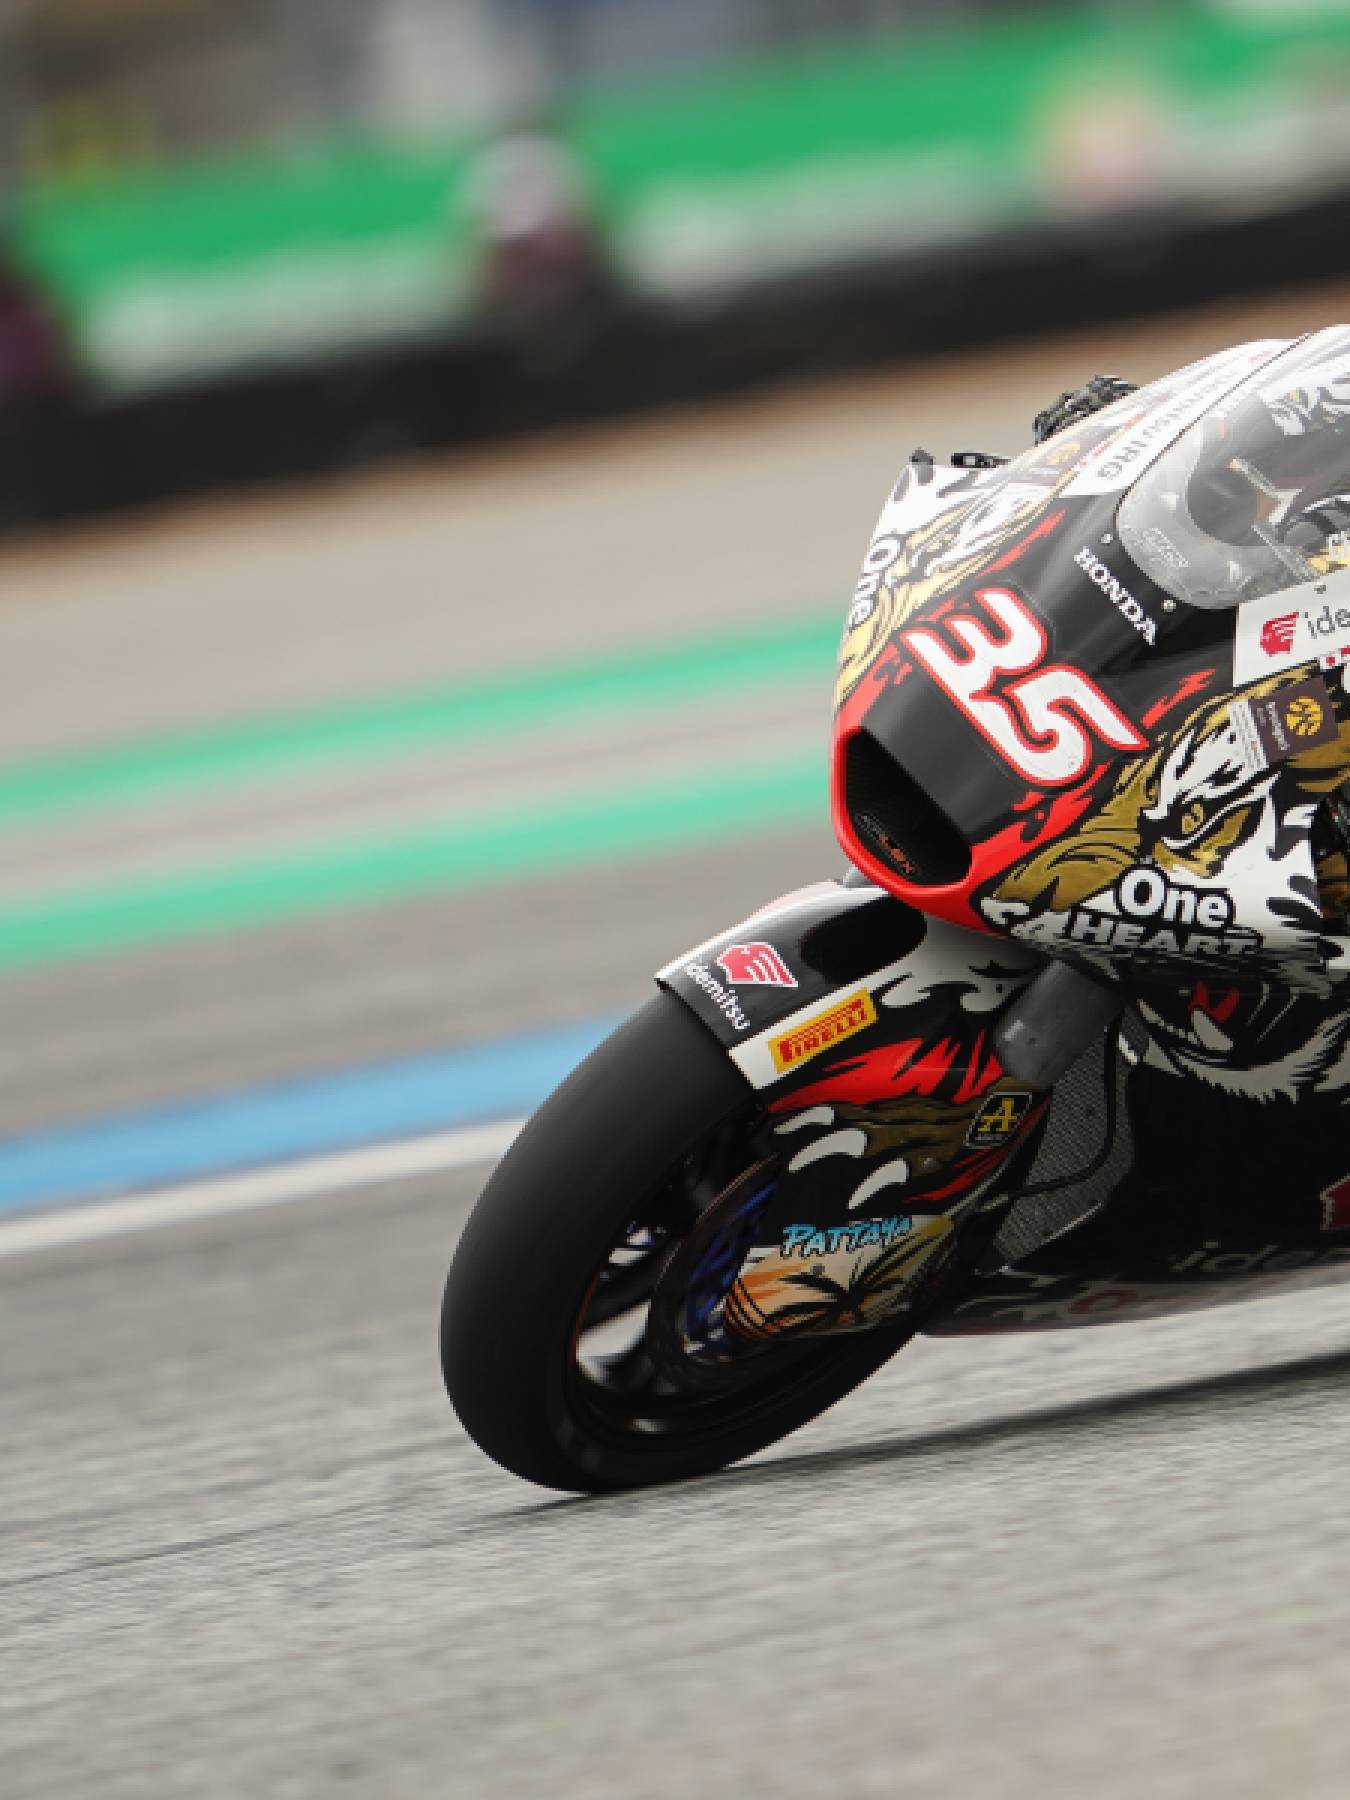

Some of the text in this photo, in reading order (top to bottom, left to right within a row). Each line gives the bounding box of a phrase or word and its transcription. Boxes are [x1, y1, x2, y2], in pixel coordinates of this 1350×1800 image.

[1074, 546, 1158, 646] HONDA
[901, 586, 1149, 788] 35
[1120, 868, 1228, 928] One
[1071, 913, 1259, 955] HEART
[777, 998, 867, 1063] PIRELLI
[781, 1216, 911, 1256] PATTAYA
